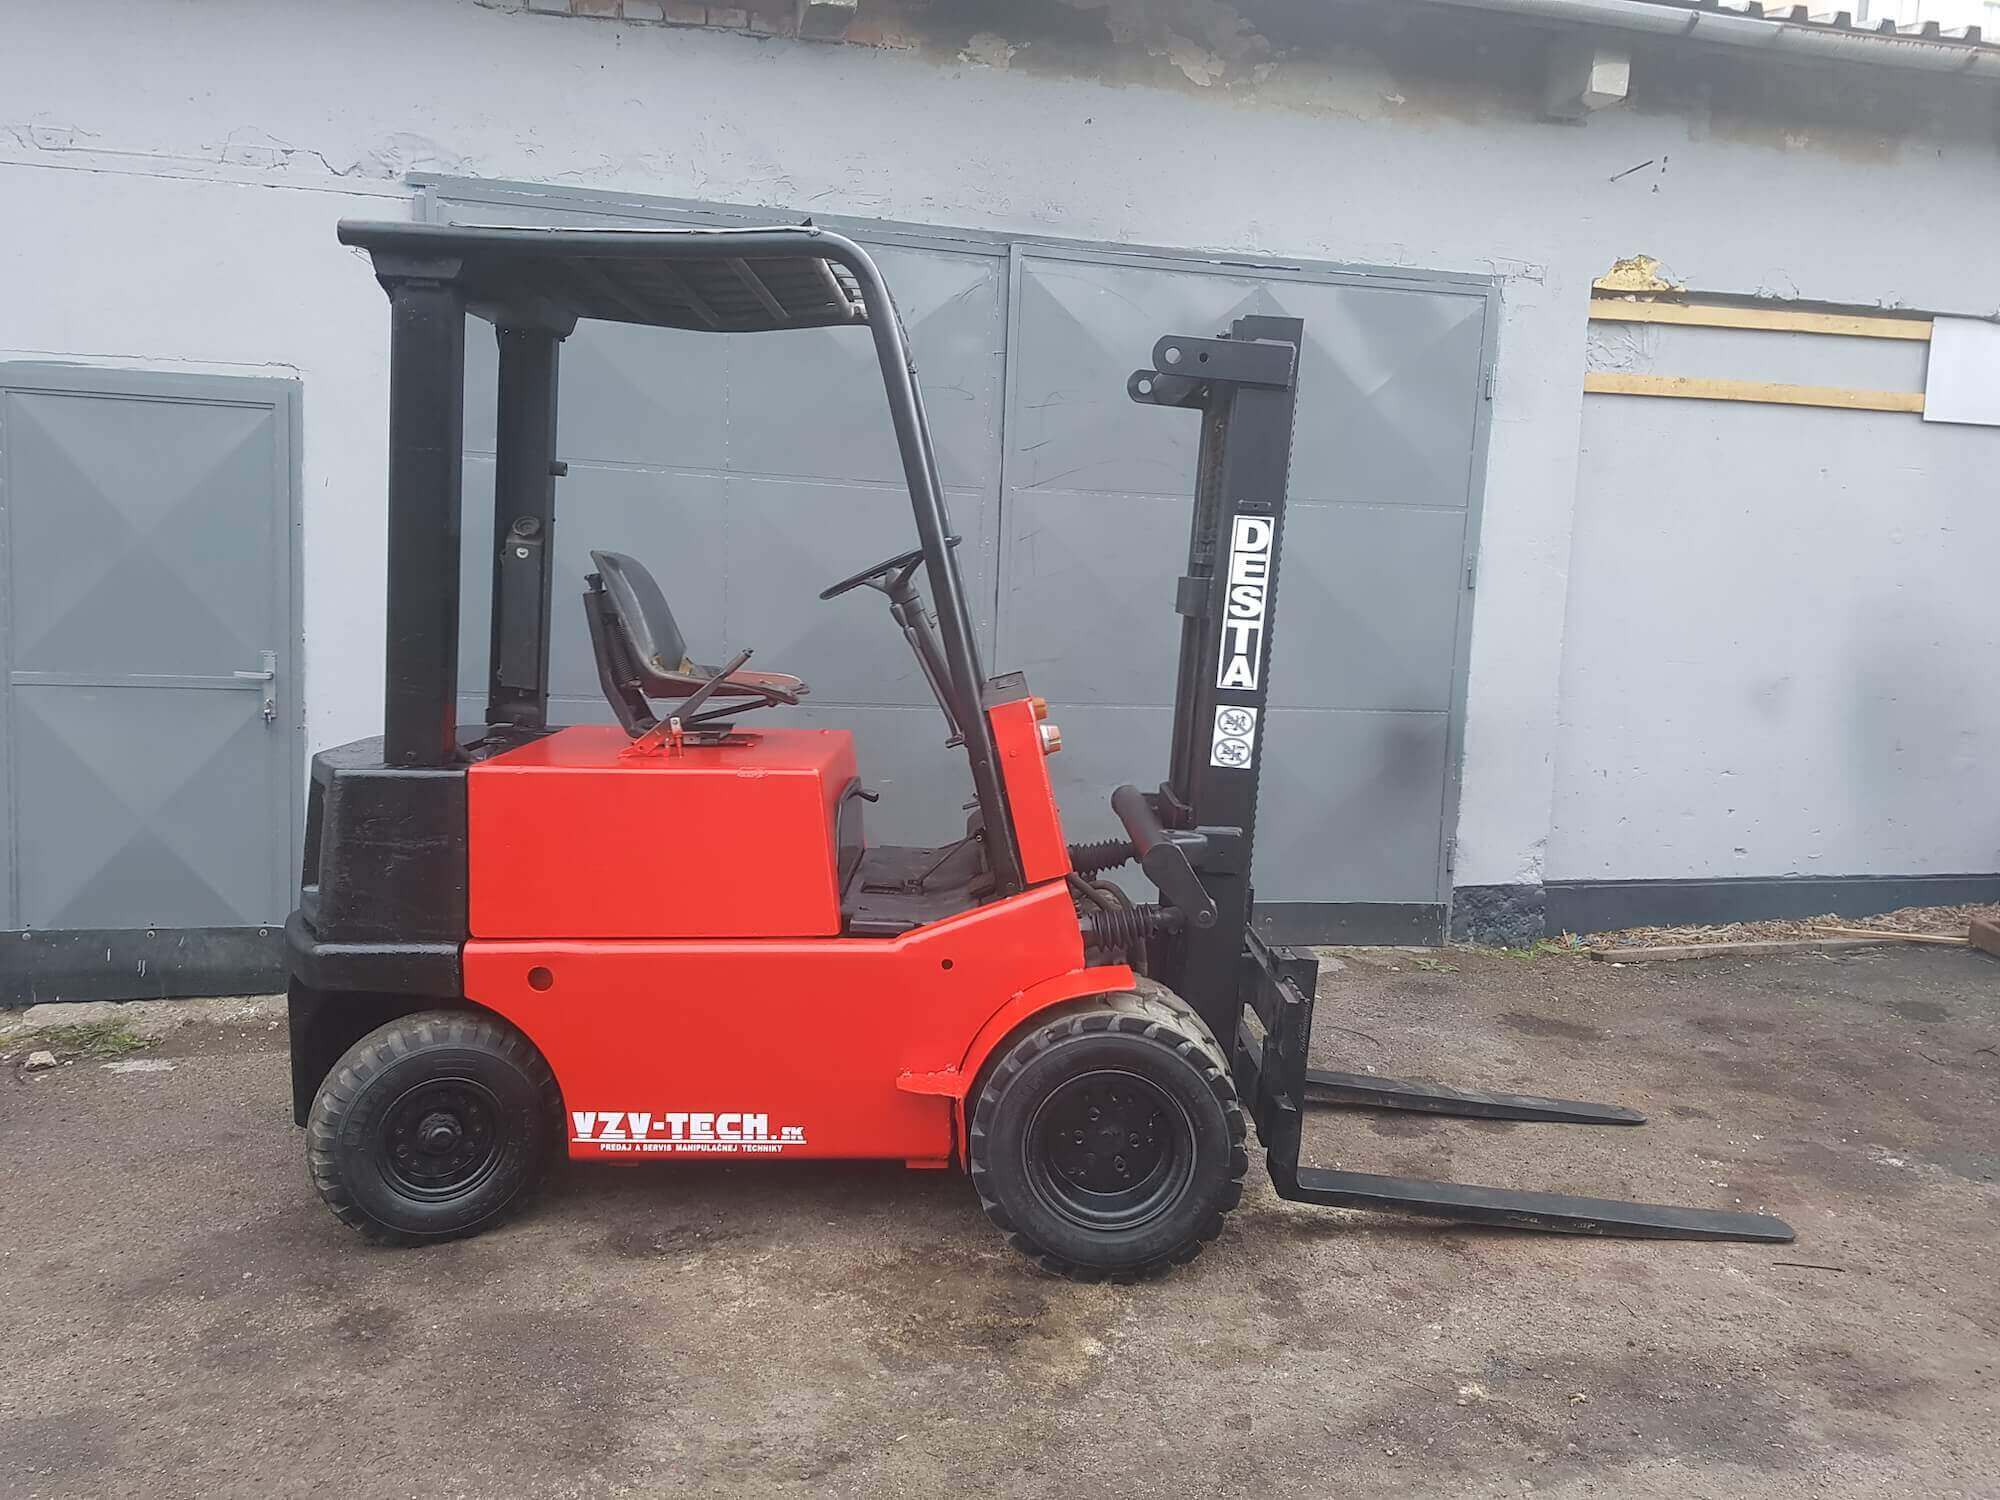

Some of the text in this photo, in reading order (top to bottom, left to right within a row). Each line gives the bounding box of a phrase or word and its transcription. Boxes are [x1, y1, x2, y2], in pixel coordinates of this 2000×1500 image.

[1220, 517, 1271, 688] DESTA
[600, 1142, 783, 1153] PREDAJ A SERVIS MANIPULAČNEJ TECHNIKY
